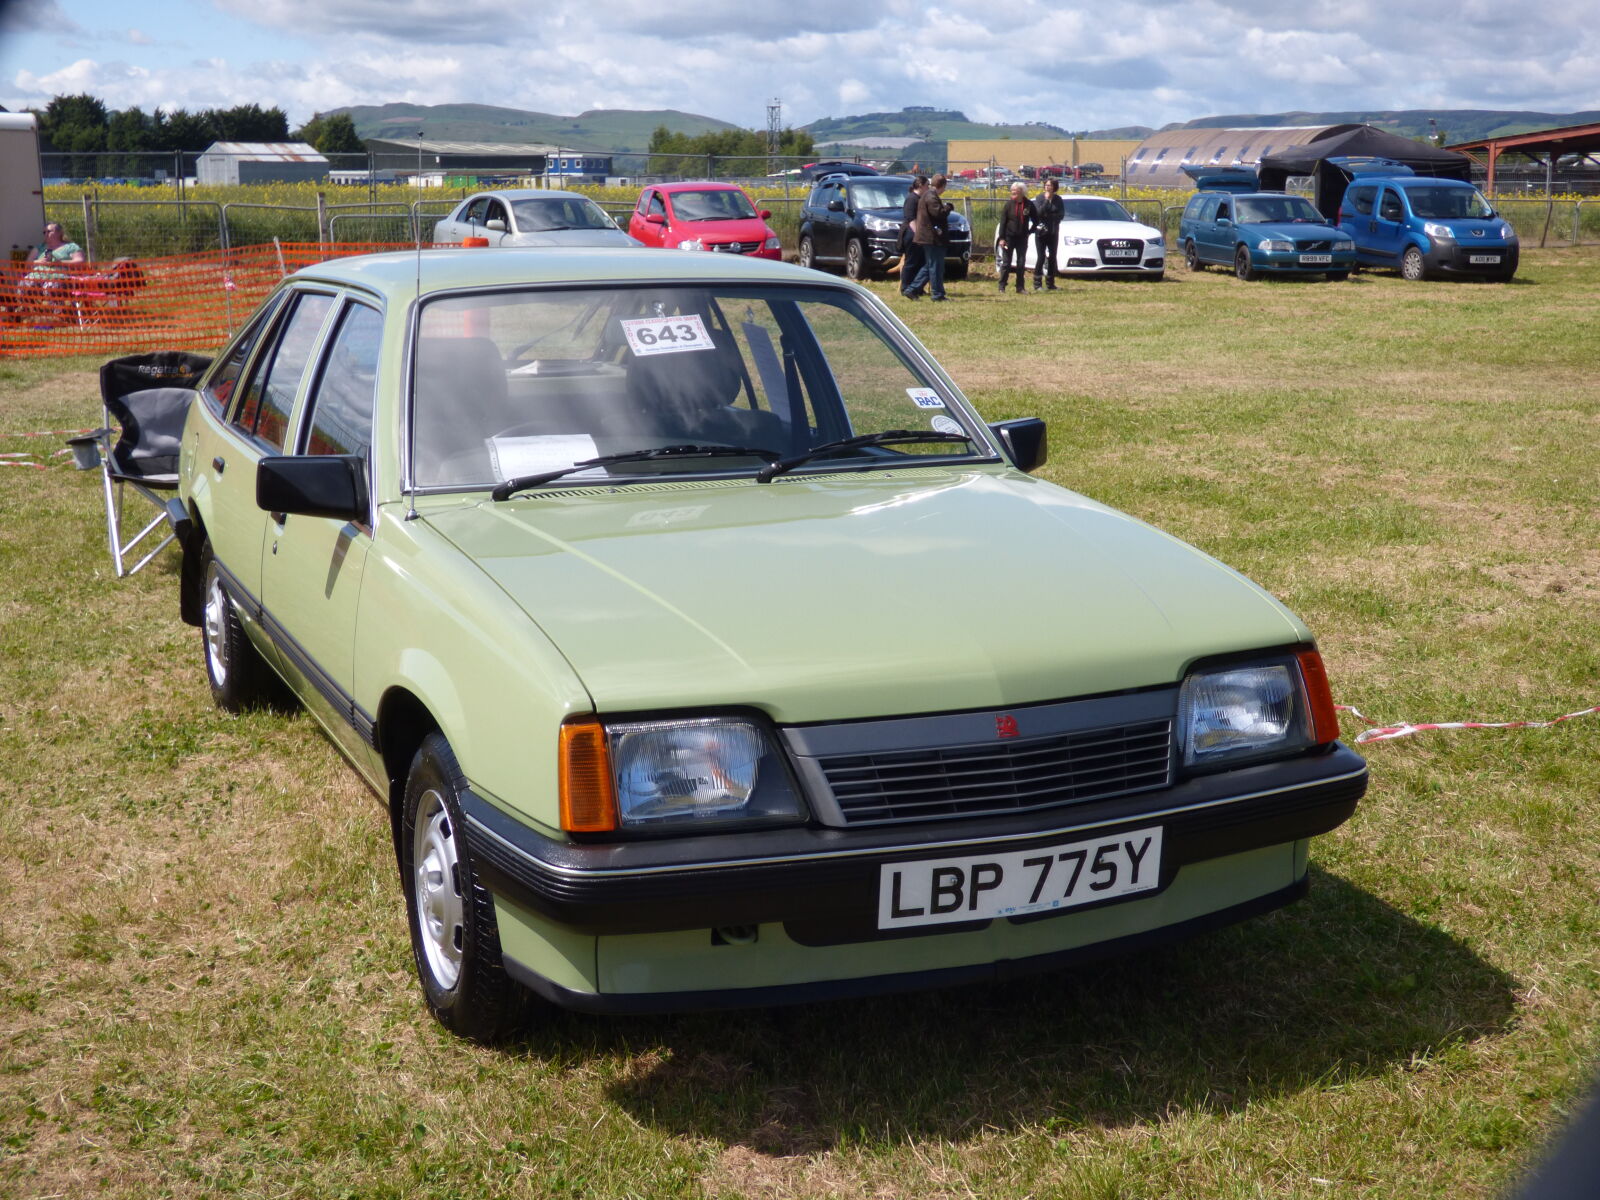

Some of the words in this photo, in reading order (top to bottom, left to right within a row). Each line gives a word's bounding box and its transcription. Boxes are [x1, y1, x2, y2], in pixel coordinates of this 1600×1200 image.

[636, 324, 698, 346] 643
[914, 396, 942, 406] RAC
[890, 862, 1004, 919] LBP
[1023, 836, 1152, 904] 775Y
